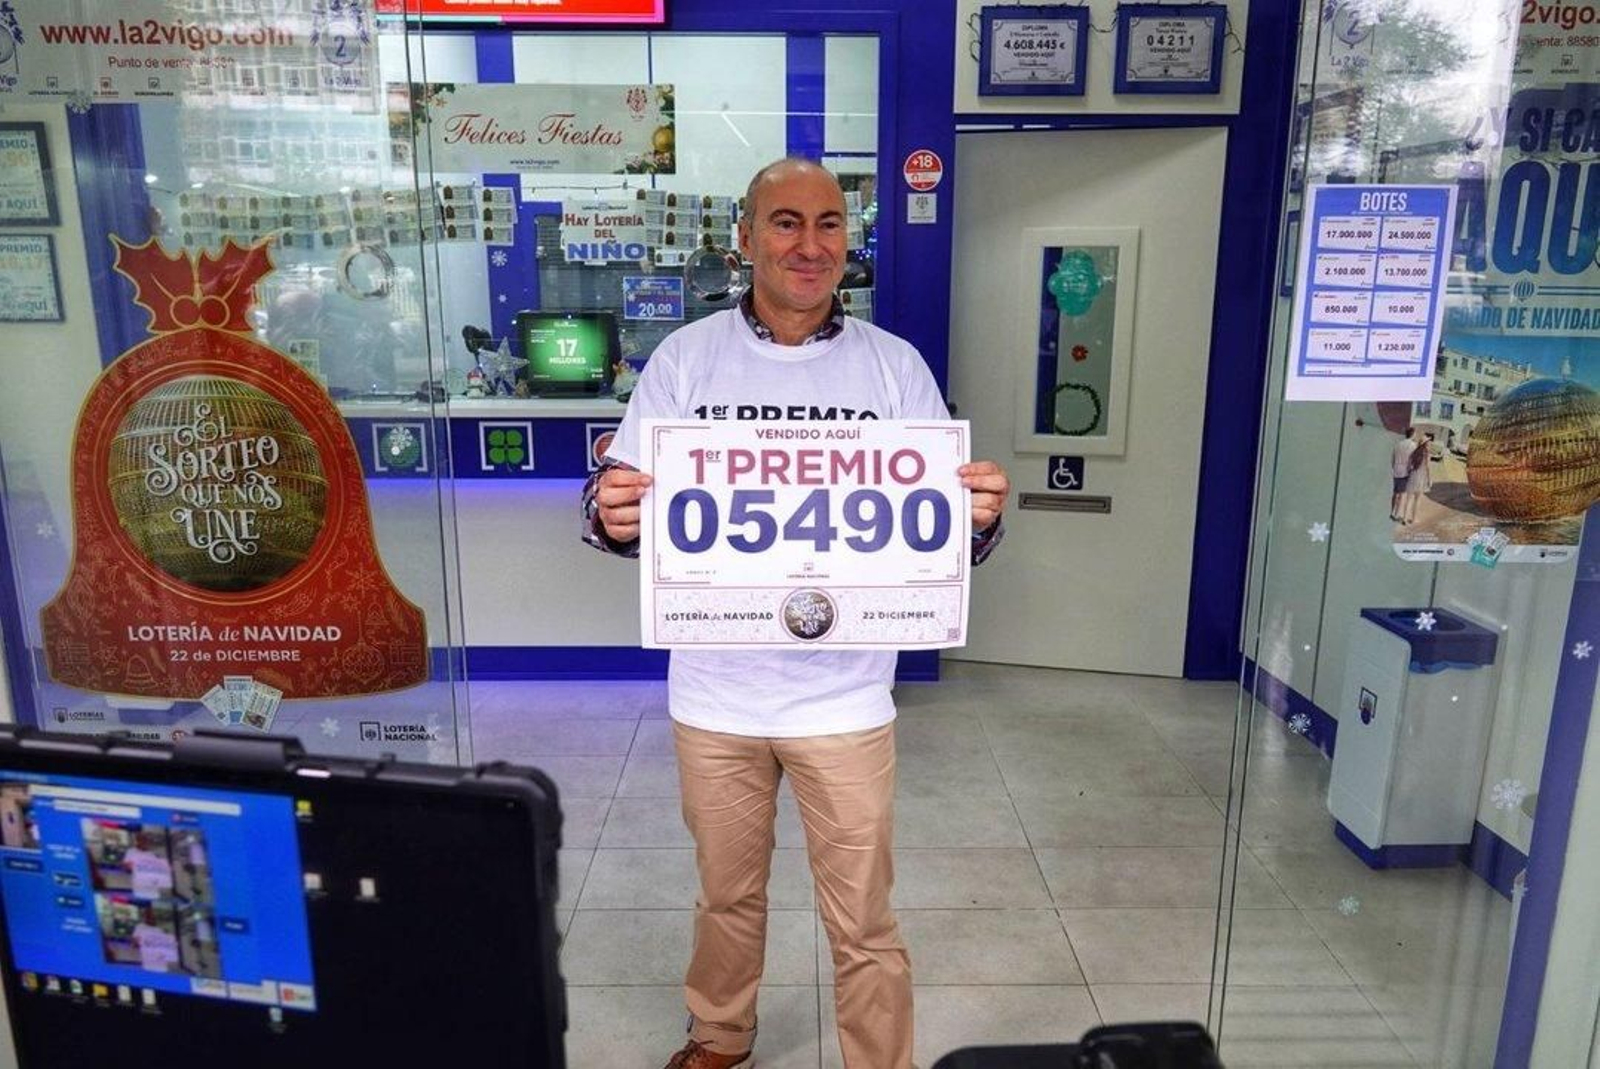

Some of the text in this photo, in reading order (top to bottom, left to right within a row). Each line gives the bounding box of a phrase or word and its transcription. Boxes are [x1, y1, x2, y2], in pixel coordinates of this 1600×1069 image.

[40, 19, 294, 50] www.la2vigo.com
[108, 56, 142, 69] Punto
[144, 57, 159, 69] de
[444, 113, 623, 146] Felices Fiestas
[1520, 107, 1554, 152] SI
[911, 154, 933, 168] +18
[1360, 192, 1408, 211] BOTES
[565, 213, 590, 226] HAY
[594, 229, 616, 238] DEL
[1325, 230, 1373, 239] 17.000.000
[567, 239, 646, 260] NIÑO
[1506, 307, 1528, 329] DE
[1531, 307, 1600, 330] NAVIDAD
[556, 338, 578, 357] 17
[755, 427, 862, 441] VENDIDO AQUÍ
[145, 435, 279, 496] SORTEO
[726, 448, 927, 486] PREMIO
[181, 470, 283, 510] QUE NOS
[667, 487, 952, 553] 05490
[170, 507, 259, 563] UNE
[666, 610, 710, 621] LOTERÍA
[723, 611, 774, 621] NAVIDAD
[862, 610, 936, 620] 22 DICIEMBRE
[127, 622, 342, 642] LOTERÍA de NAVIDAD
[169, 650, 301, 662] 22 de DICIEMBRE
[385, 733, 437, 742] NACIONAL
